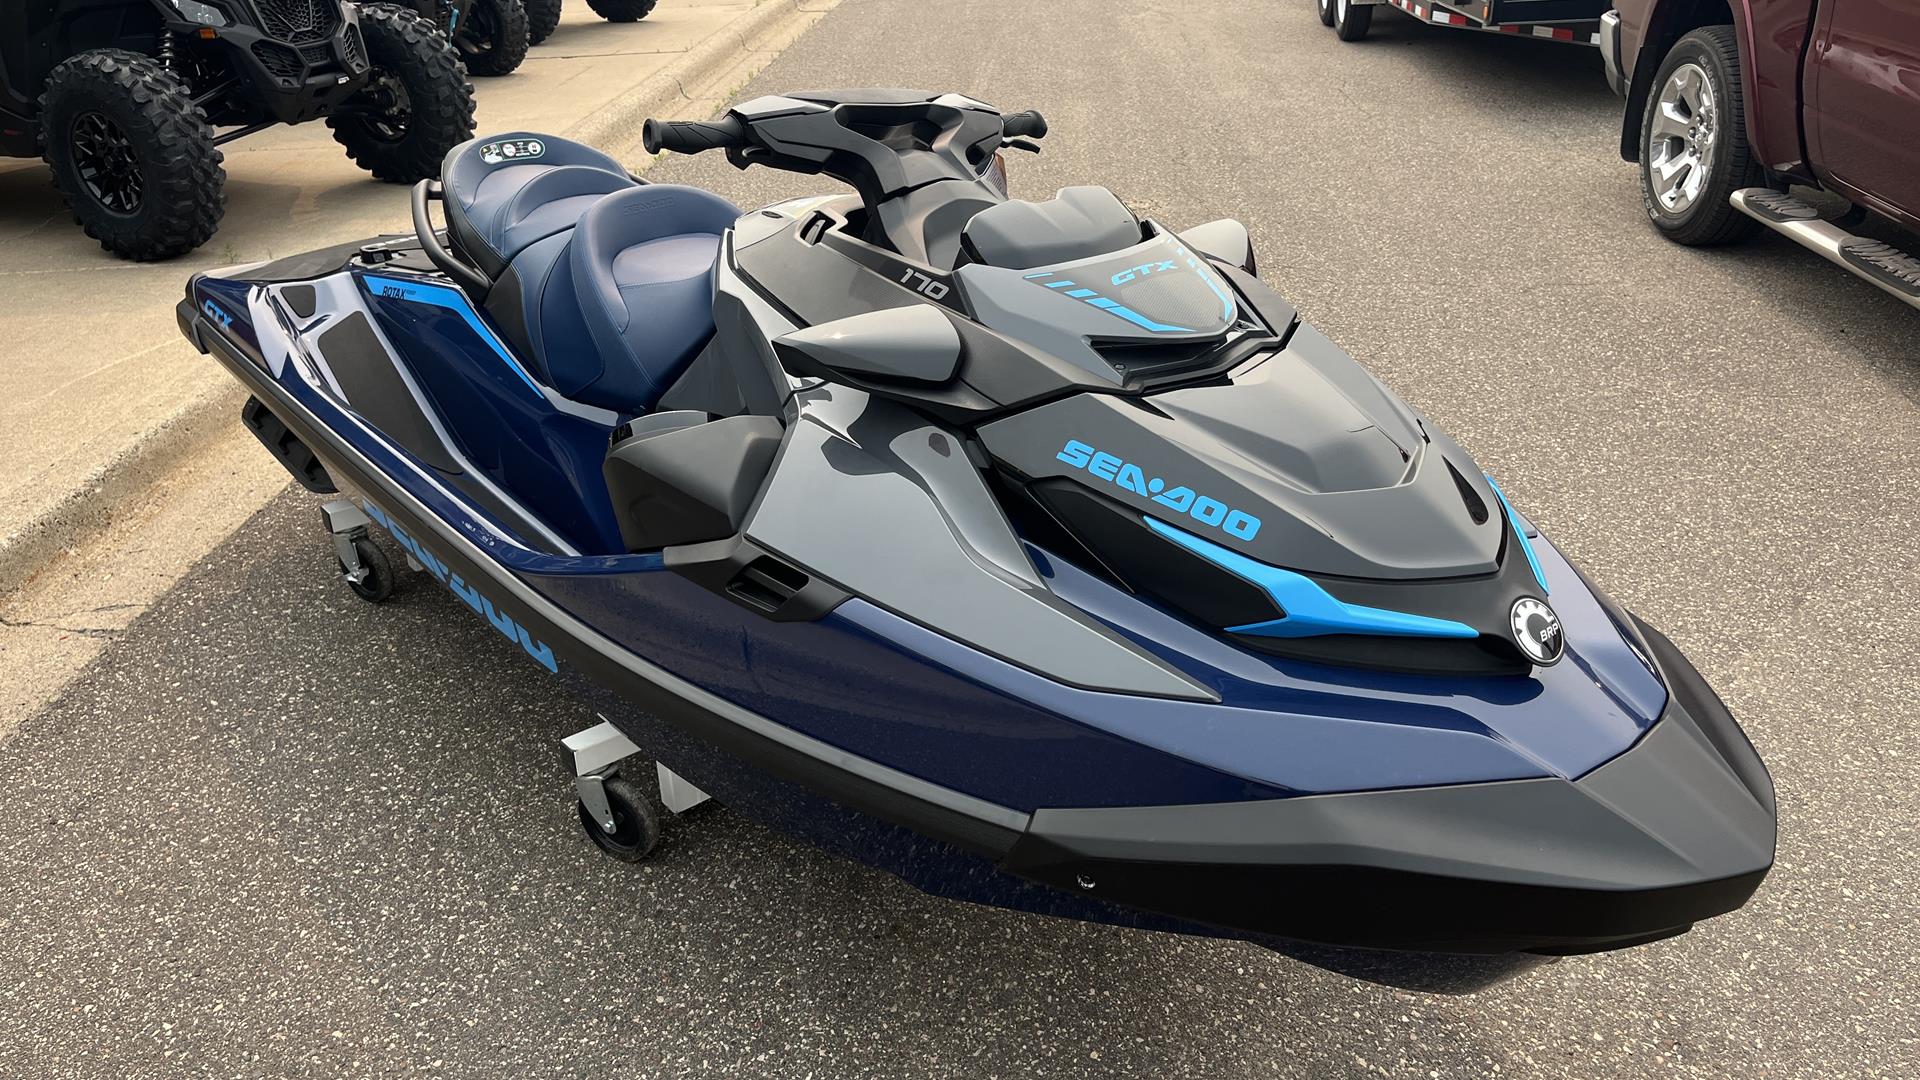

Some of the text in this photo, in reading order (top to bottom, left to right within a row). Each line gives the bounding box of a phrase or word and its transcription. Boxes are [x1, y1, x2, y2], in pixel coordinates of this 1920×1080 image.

[900, 267, 950, 300] 170
[1111, 260, 1179, 286] GTX
[382, 286, 407, 300] ROTAX
[204, 299, 233, 332] GTX
[1540, 622, 1559, 643] BRP
